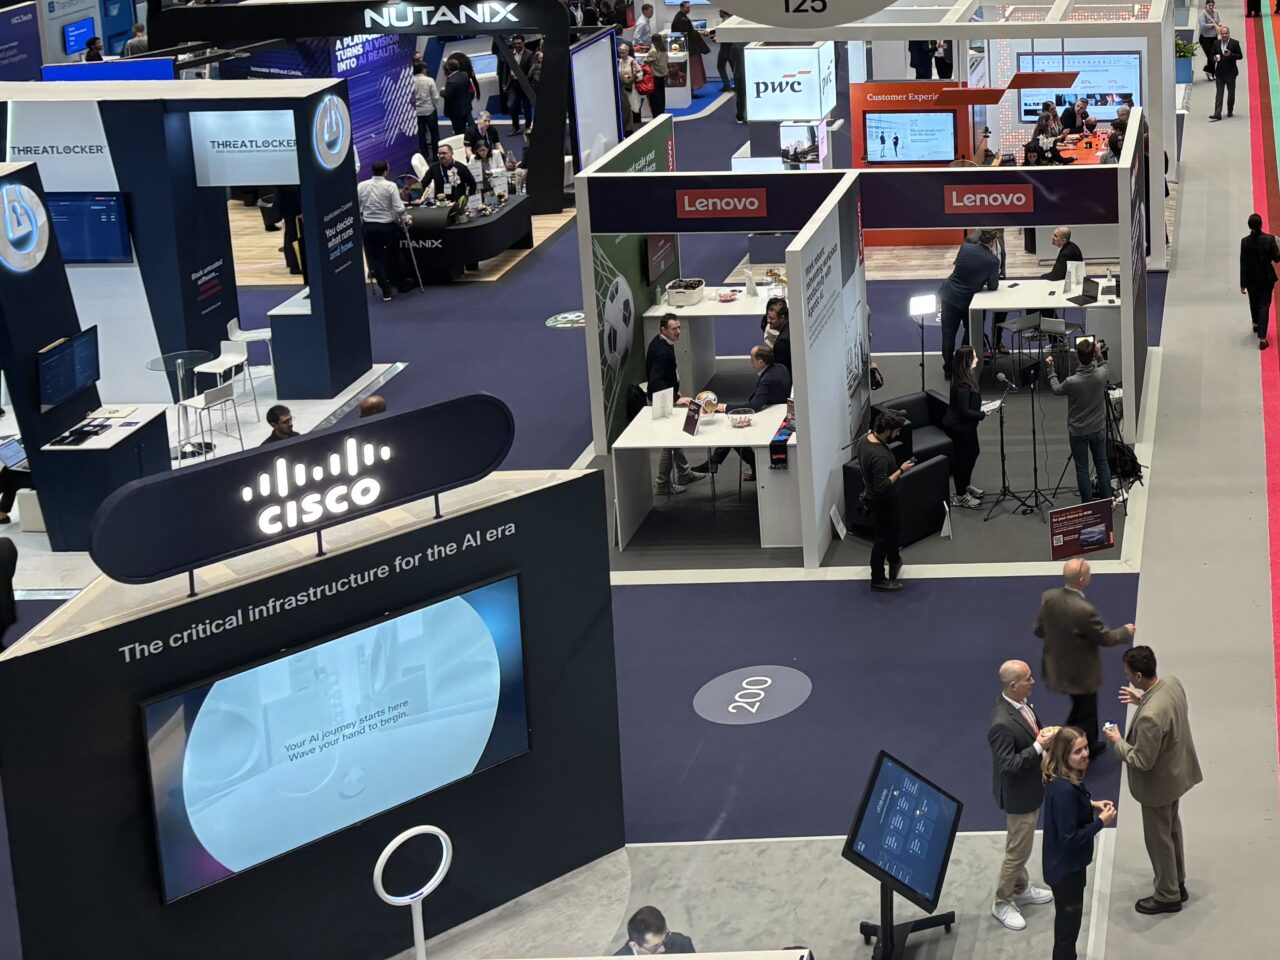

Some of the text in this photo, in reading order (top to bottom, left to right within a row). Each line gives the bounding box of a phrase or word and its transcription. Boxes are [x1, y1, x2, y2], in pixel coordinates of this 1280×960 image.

[364, 1, 520, 30] NUTANIX
[335, 39, 343, 51] A
[335, 34, 400, 62] TURNS AI VISION
[336, 43, 401, 73] INTO AI REALITY.
[753, 77, 803, 99] pwc
[866, 93, 907, 102] Customer
[11, 146, 105, 157] THREATLOCKER
[683, 194, 759, 212] Lenovo
[951, 189, 1026, 207] Lenovo
[325, 215, 354, 239] You decide
[341, 228, 354, 240] runs
[258, 478, 381, 536] CISCO
[118, 521, 517, 665] The critical infrastructure for the AI era
[728, 674, 773, 715] 200
[284, 708, 386, 753] Your AI journey starts
[288, 710, 409, 763] Wave your hand to begin.
